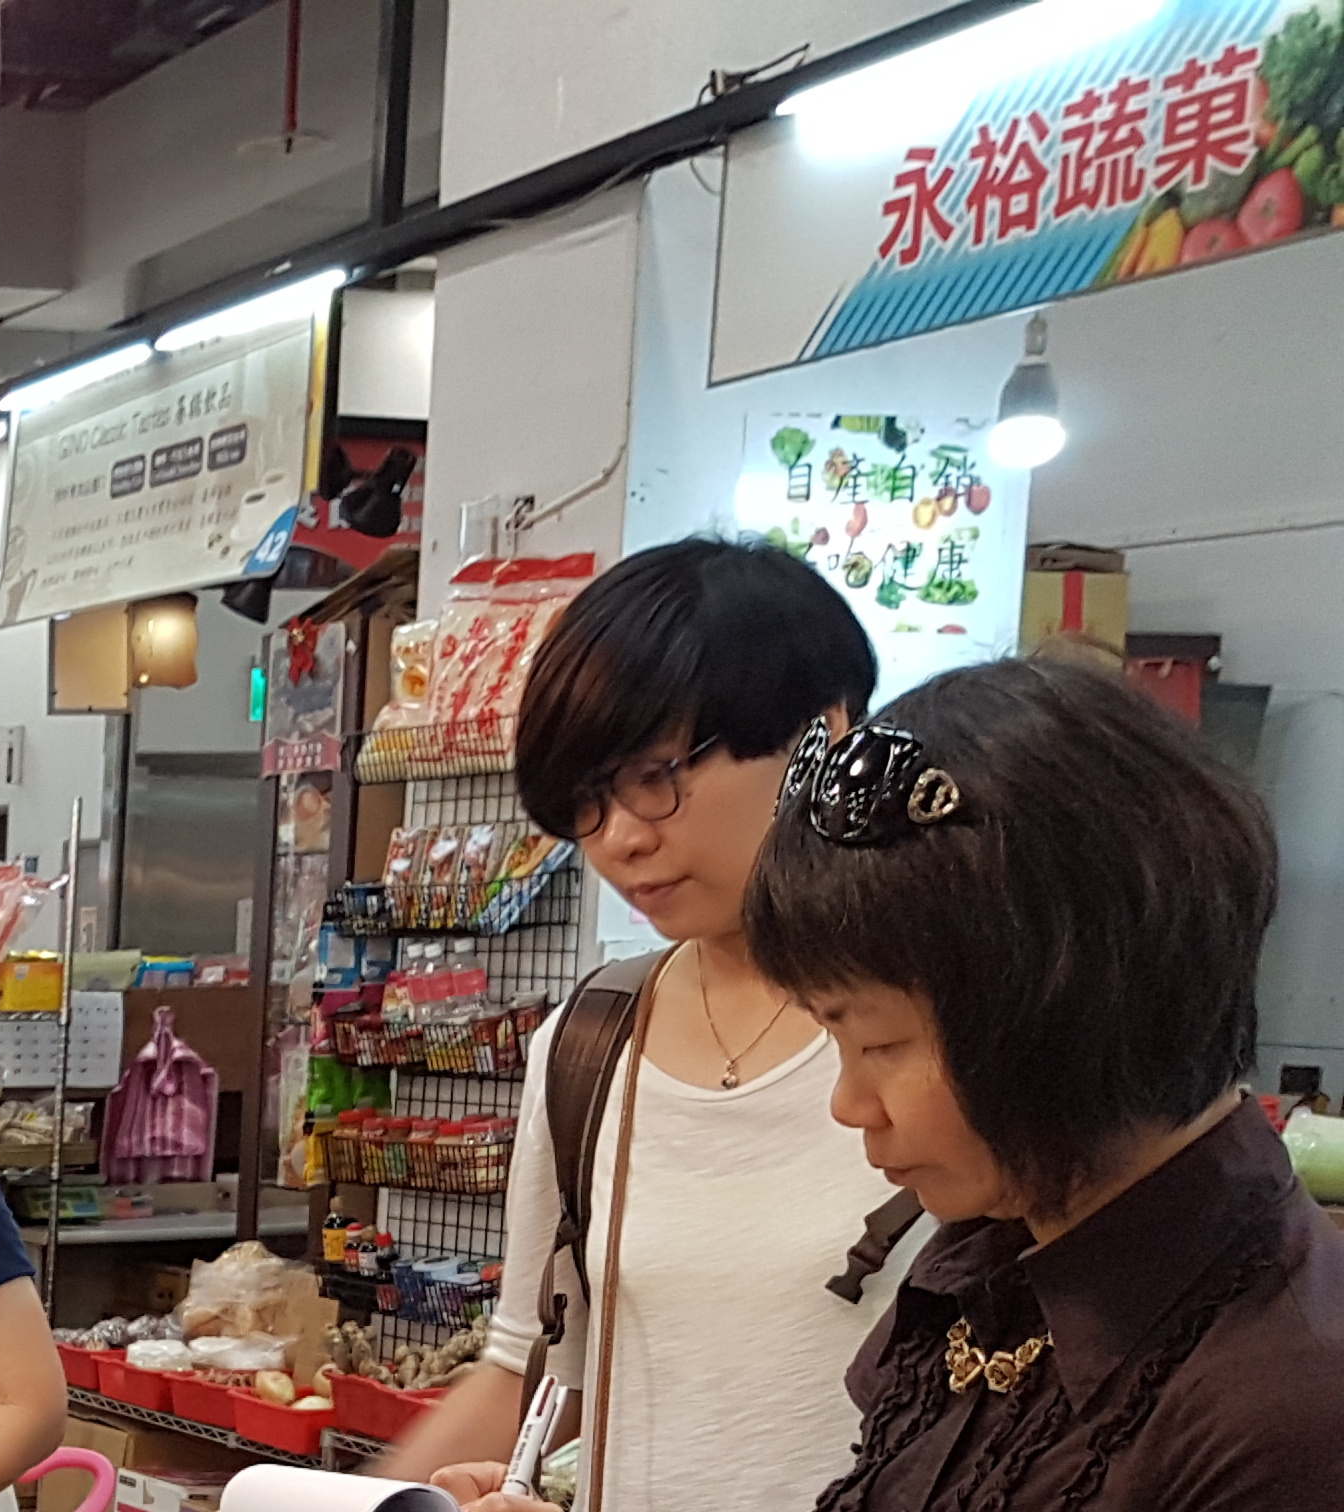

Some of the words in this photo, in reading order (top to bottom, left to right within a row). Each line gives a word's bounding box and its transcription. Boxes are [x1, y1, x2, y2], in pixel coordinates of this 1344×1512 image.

[876, 46, 1268, 266] 永裕蔬菓
[786, 453, 977, 505] 自產自銷
[255, 527, 288, 565] 42
[802, 538, 969, 591] 吃健康
